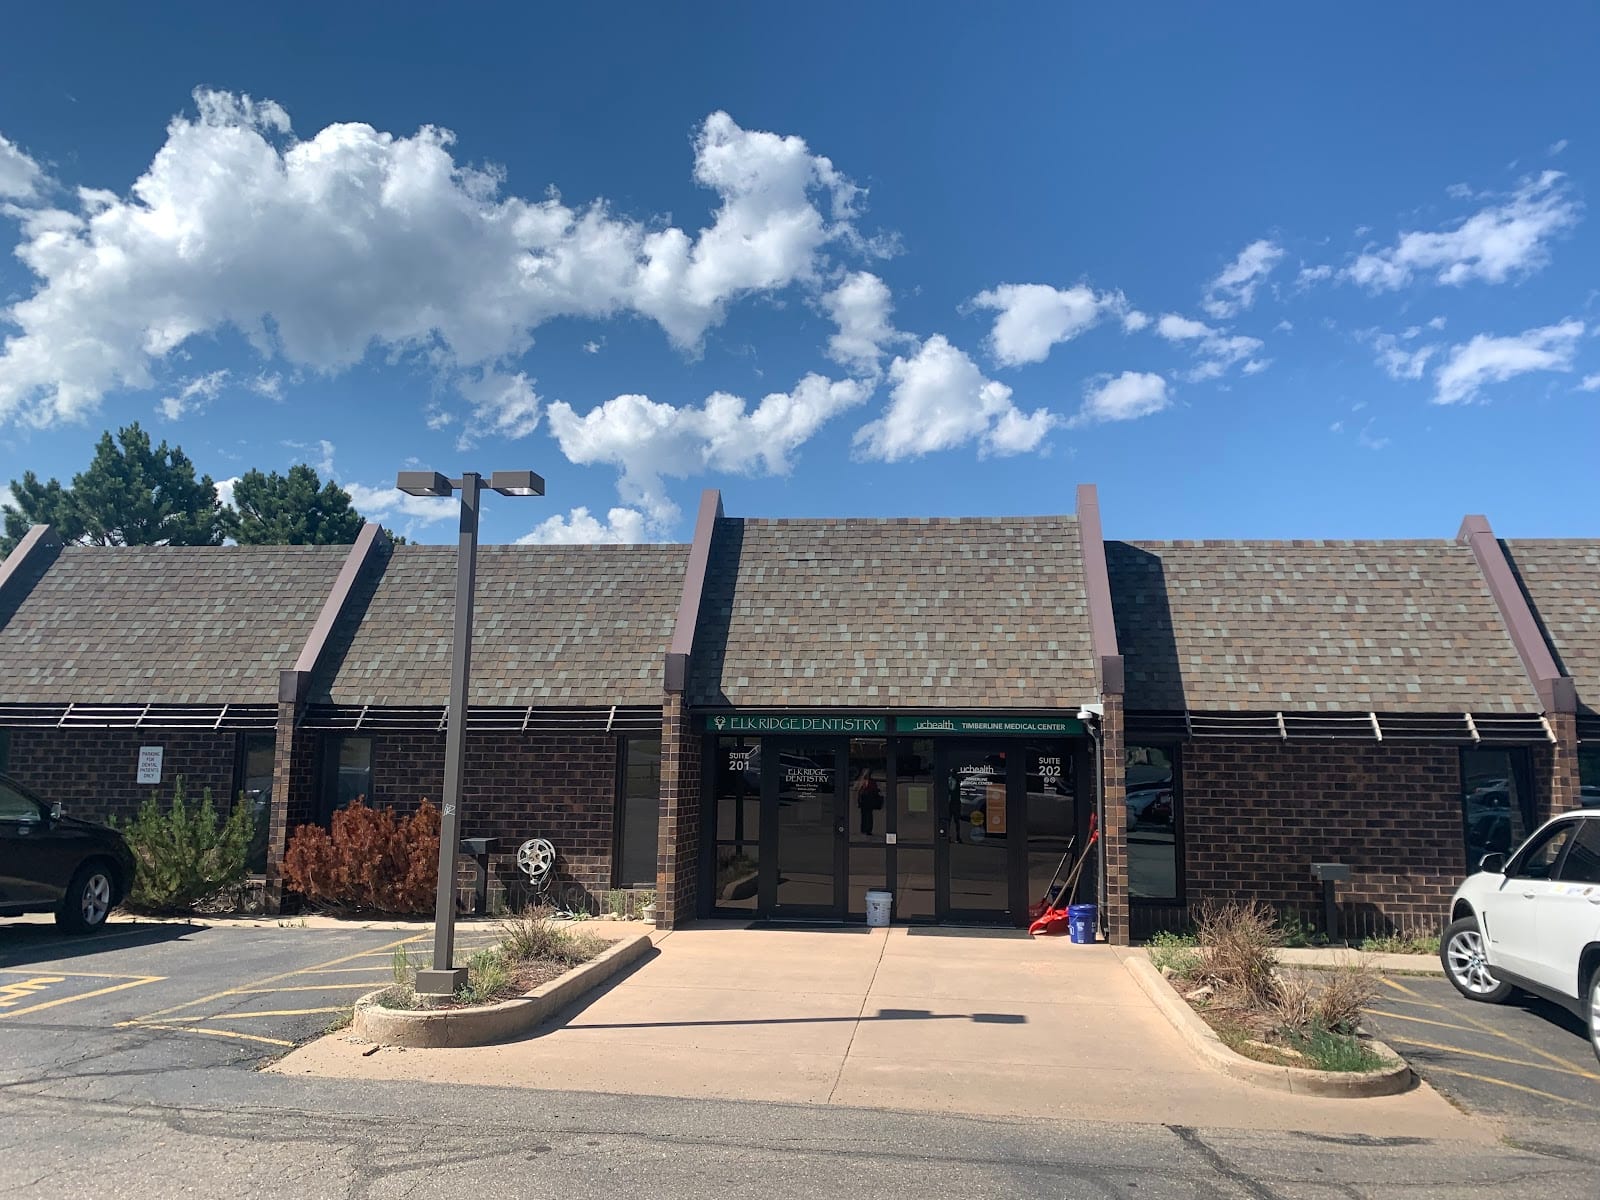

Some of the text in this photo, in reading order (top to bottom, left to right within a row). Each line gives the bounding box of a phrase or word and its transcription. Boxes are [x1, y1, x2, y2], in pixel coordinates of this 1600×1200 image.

[731, 718, 881, 731] ELK RIDGE DENTISTRY
[915, 719, 1066, 731] uchealth TIMBERLINE MEDICAL CENTER
[729, 752, 750, 760] SUITE
[1038, 757, 1061, 765] SUITE
[728, 761, 750, 771] 201
[960, 764, 994, 774] uchealth
[1038, 765, 1061, 777] 202
[788, 768, 827, 776] ELK RIDGE
[785, 775, 829, 783] DENTISTRY
